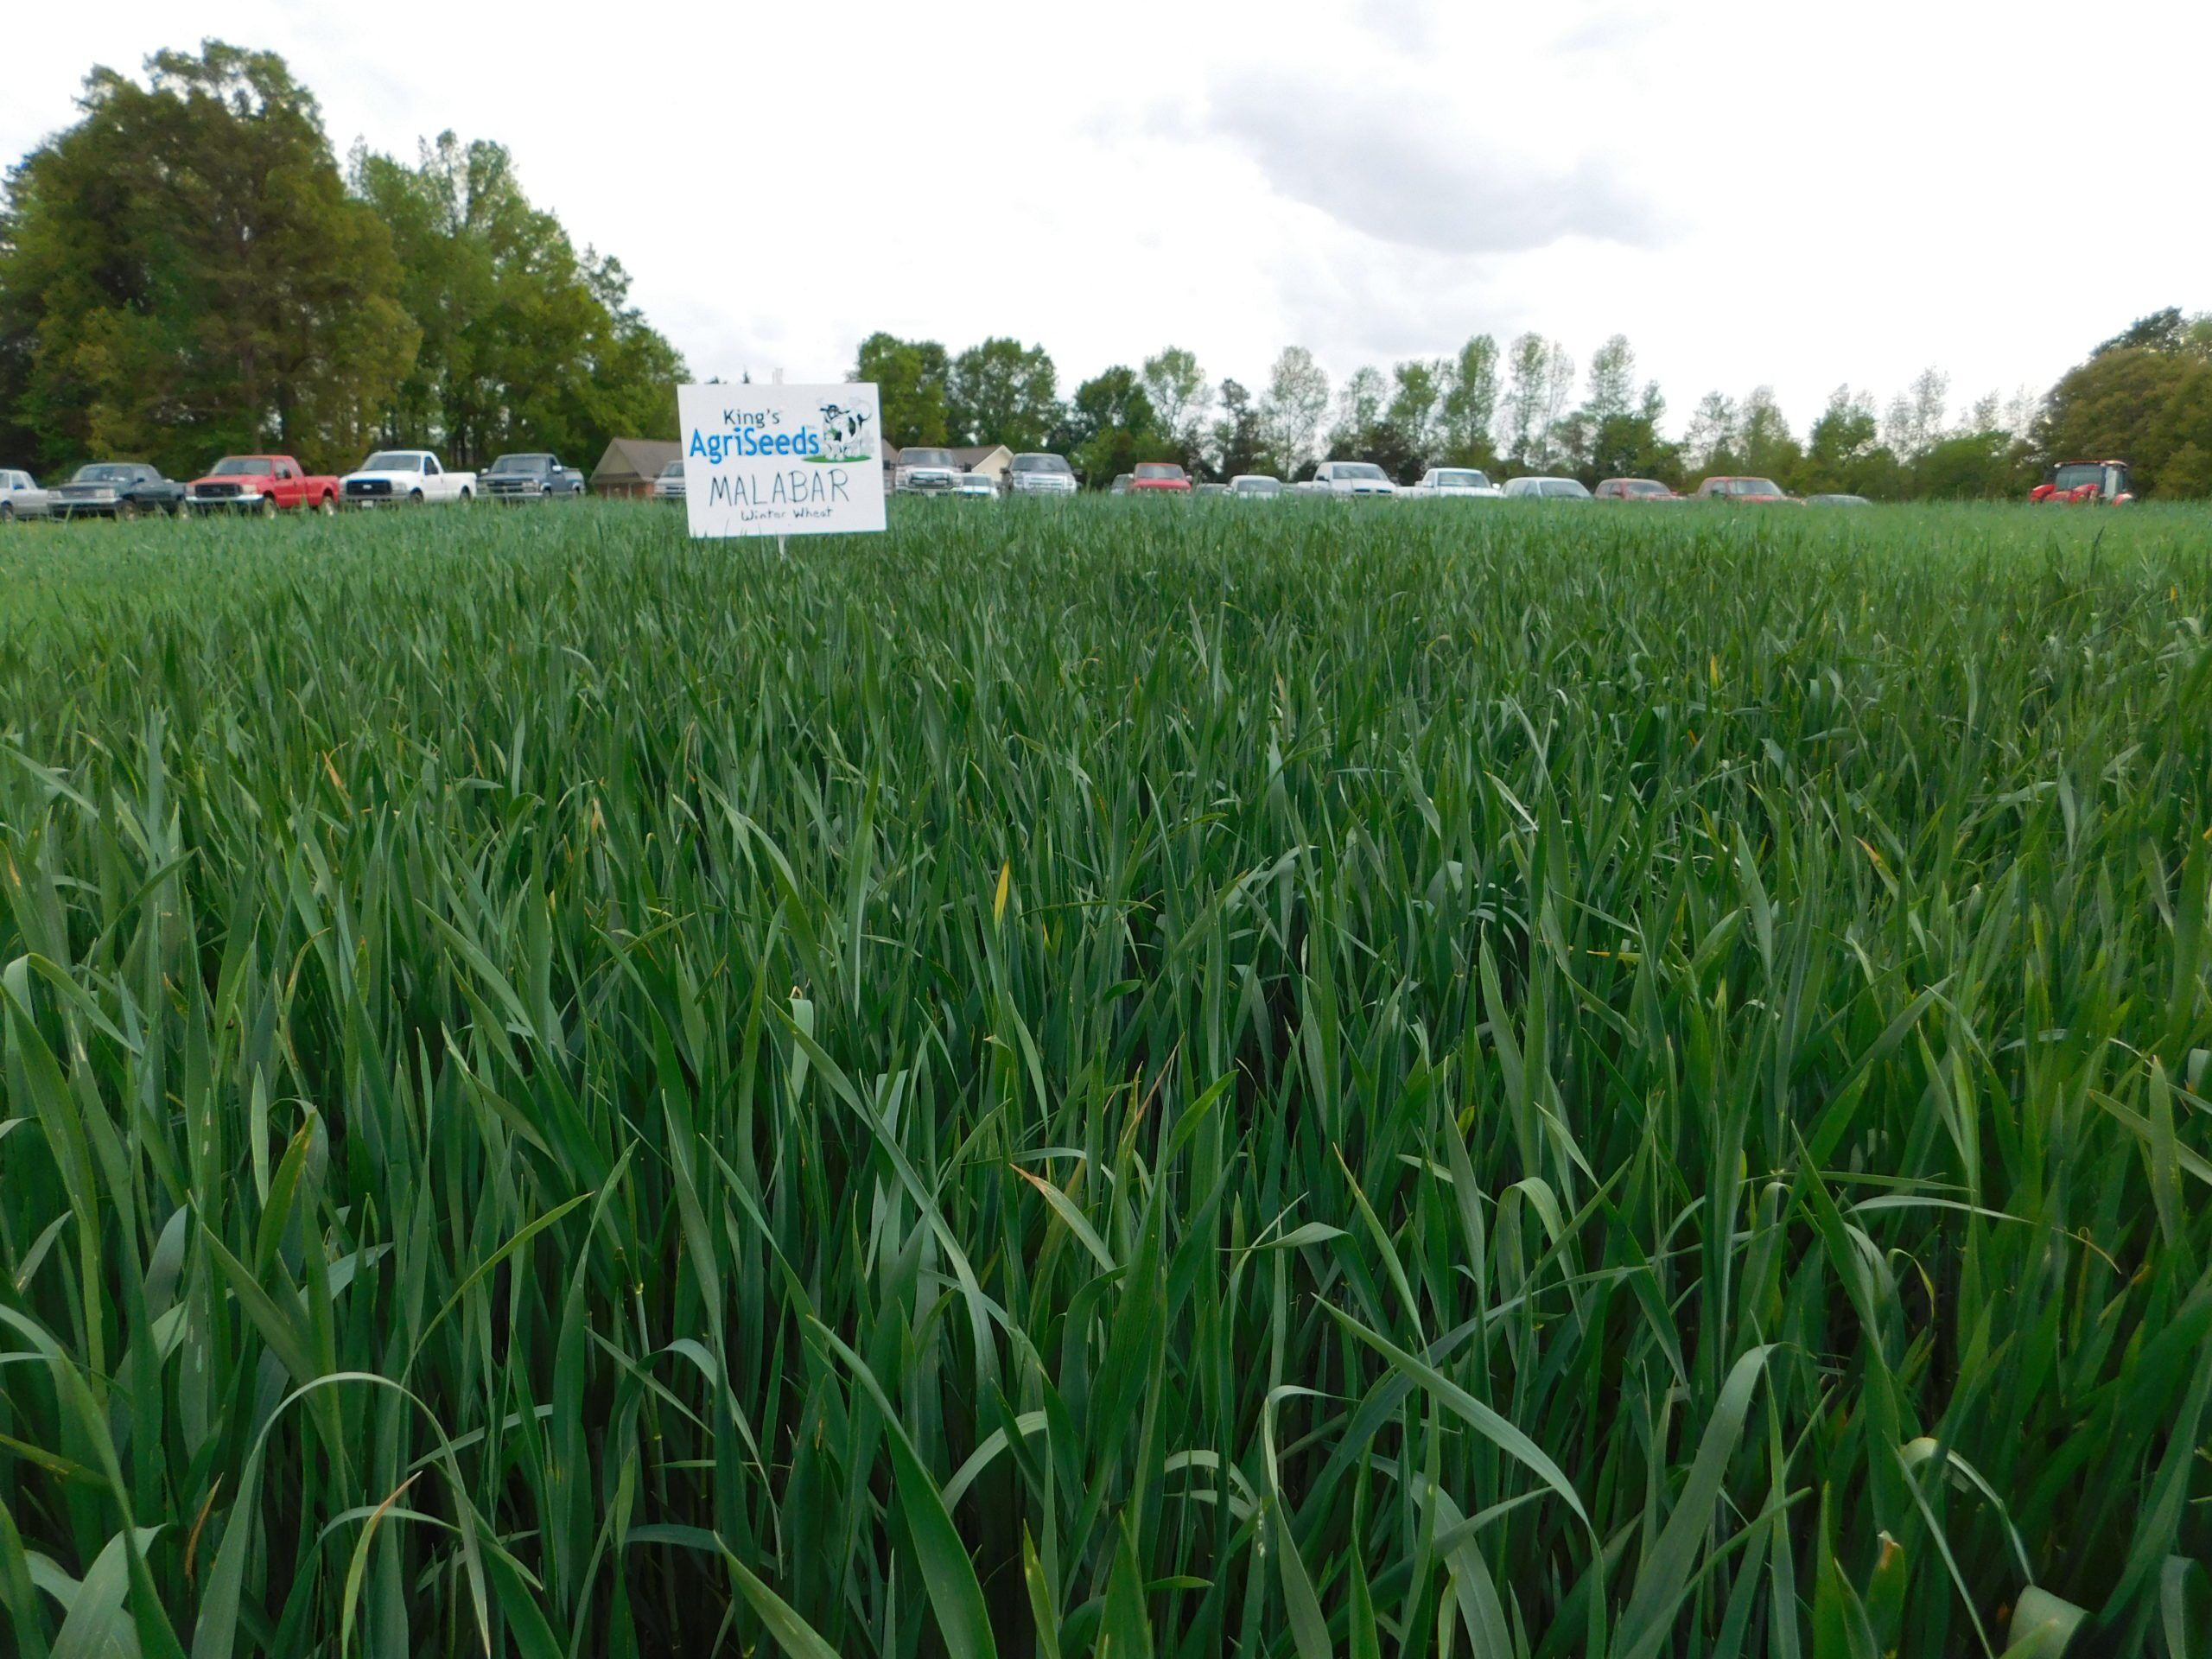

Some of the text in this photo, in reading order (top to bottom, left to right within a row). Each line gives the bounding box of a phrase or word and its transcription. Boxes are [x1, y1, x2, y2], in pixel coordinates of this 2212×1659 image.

[723, 409, 780, 428] King's
[690, 425, 820, 464] AgriSeeds
[709, 468, 849, 506] MALABAR
[741, 508, 833, 522] Winter Wheat
